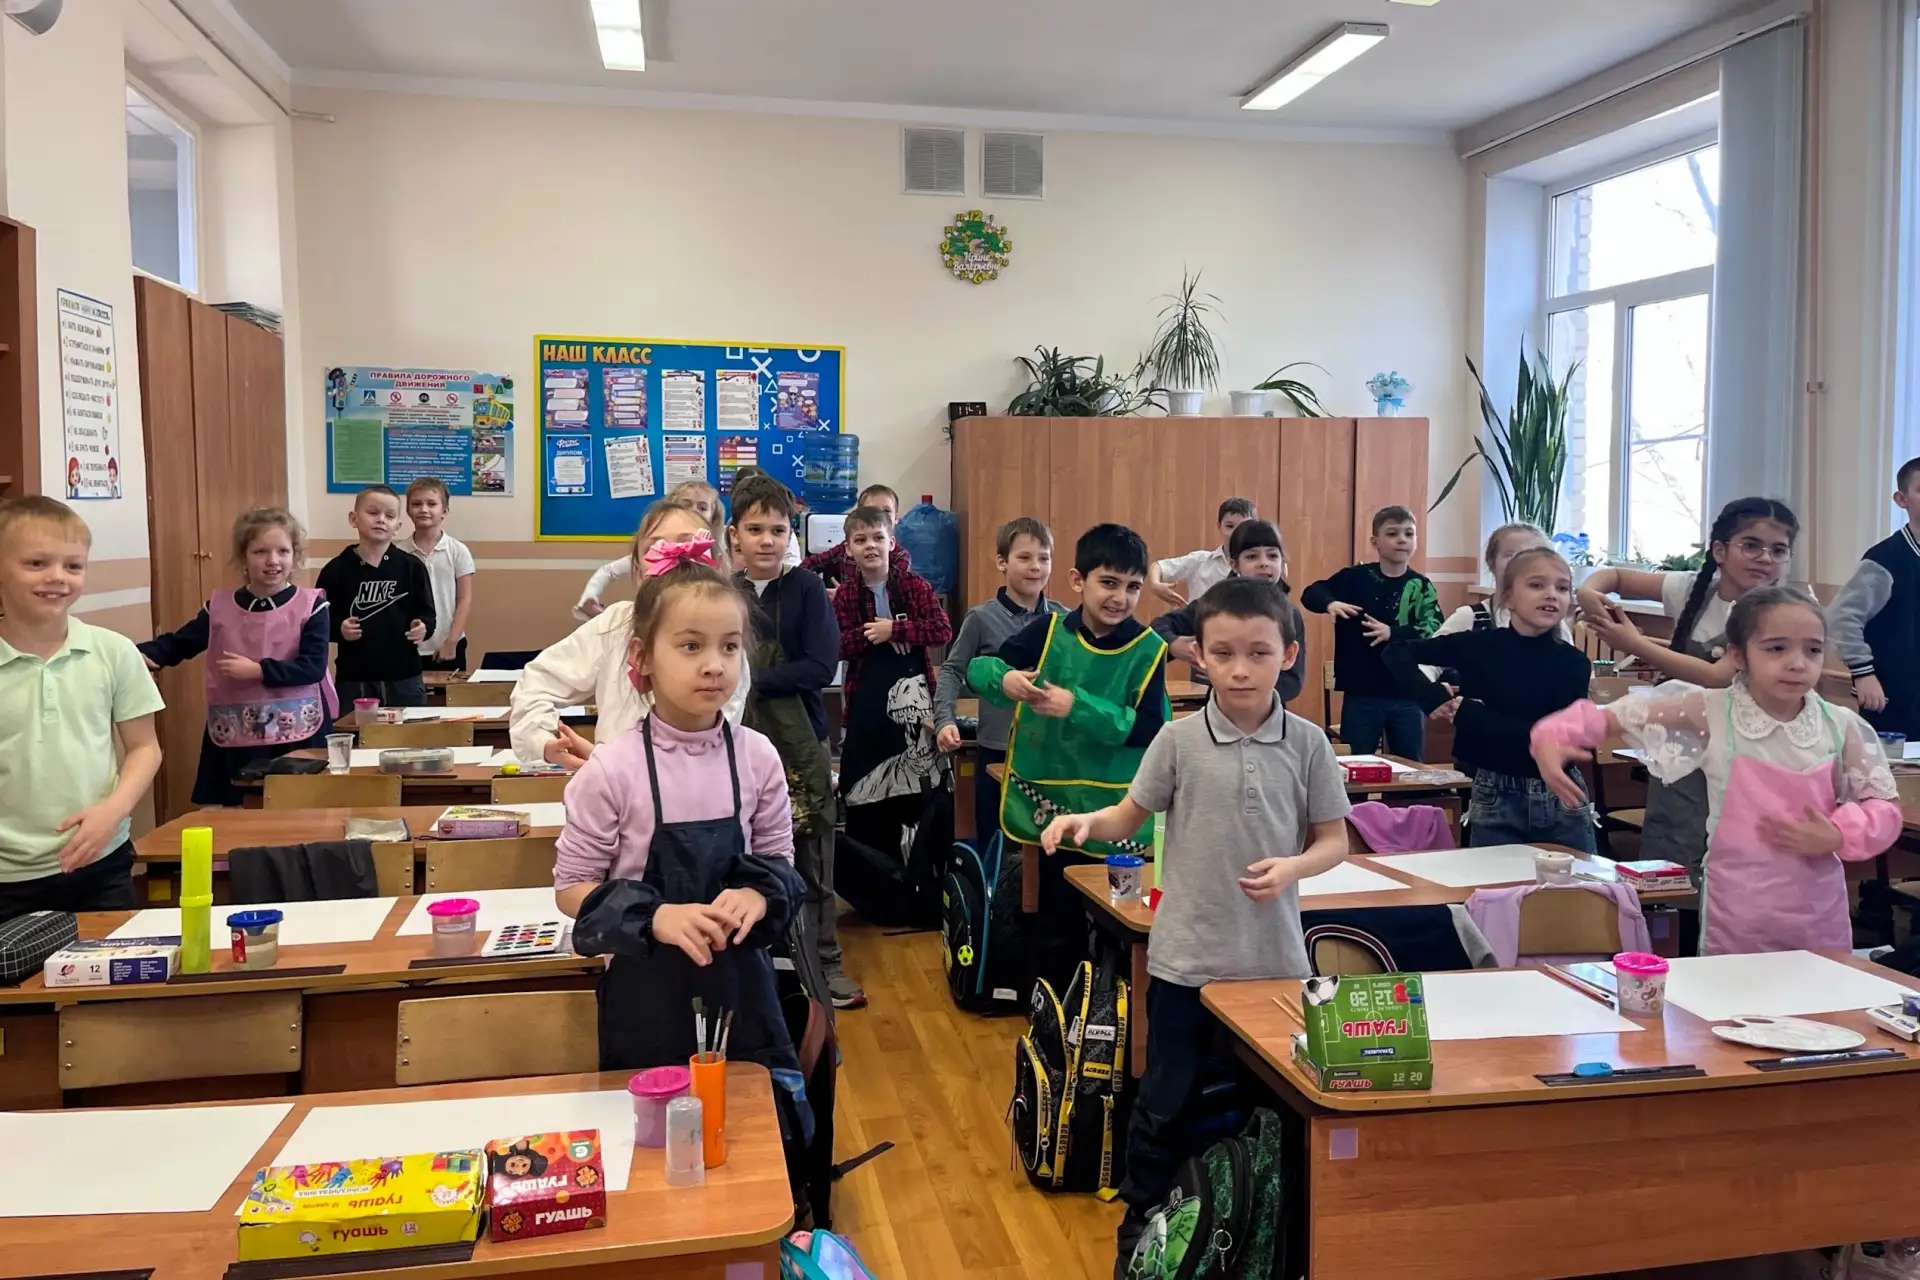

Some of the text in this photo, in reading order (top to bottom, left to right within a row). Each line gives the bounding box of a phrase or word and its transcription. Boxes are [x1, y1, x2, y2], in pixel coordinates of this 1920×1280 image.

[543, 344, 652, 365] НАШ КЛАСС
[370, 372, 470, 381] ПРАВИЛА ДОРОЖНОГО
[358, 580, 397, 603] NIKE
[90, 965, 101, 973] 12
[1349, 989, 1394, 1007] 12 20
[1342, 1018, 1408, 1038] ГУАШЬ
[1330, 1072, 1422, 1089] ГУАШЬ 12 20
[1057, 1123, 1069, 1155] ACROSS
[575, 1145, 589, 1158] 6
[509, 1174, 568, 1193] ГУАШЬ
[348, 1193, 403, 1209] гуашь
[535, 1206, 593, 1225] ГУАШЬ
[332, 1223, 416, 1243] гуашь 12
